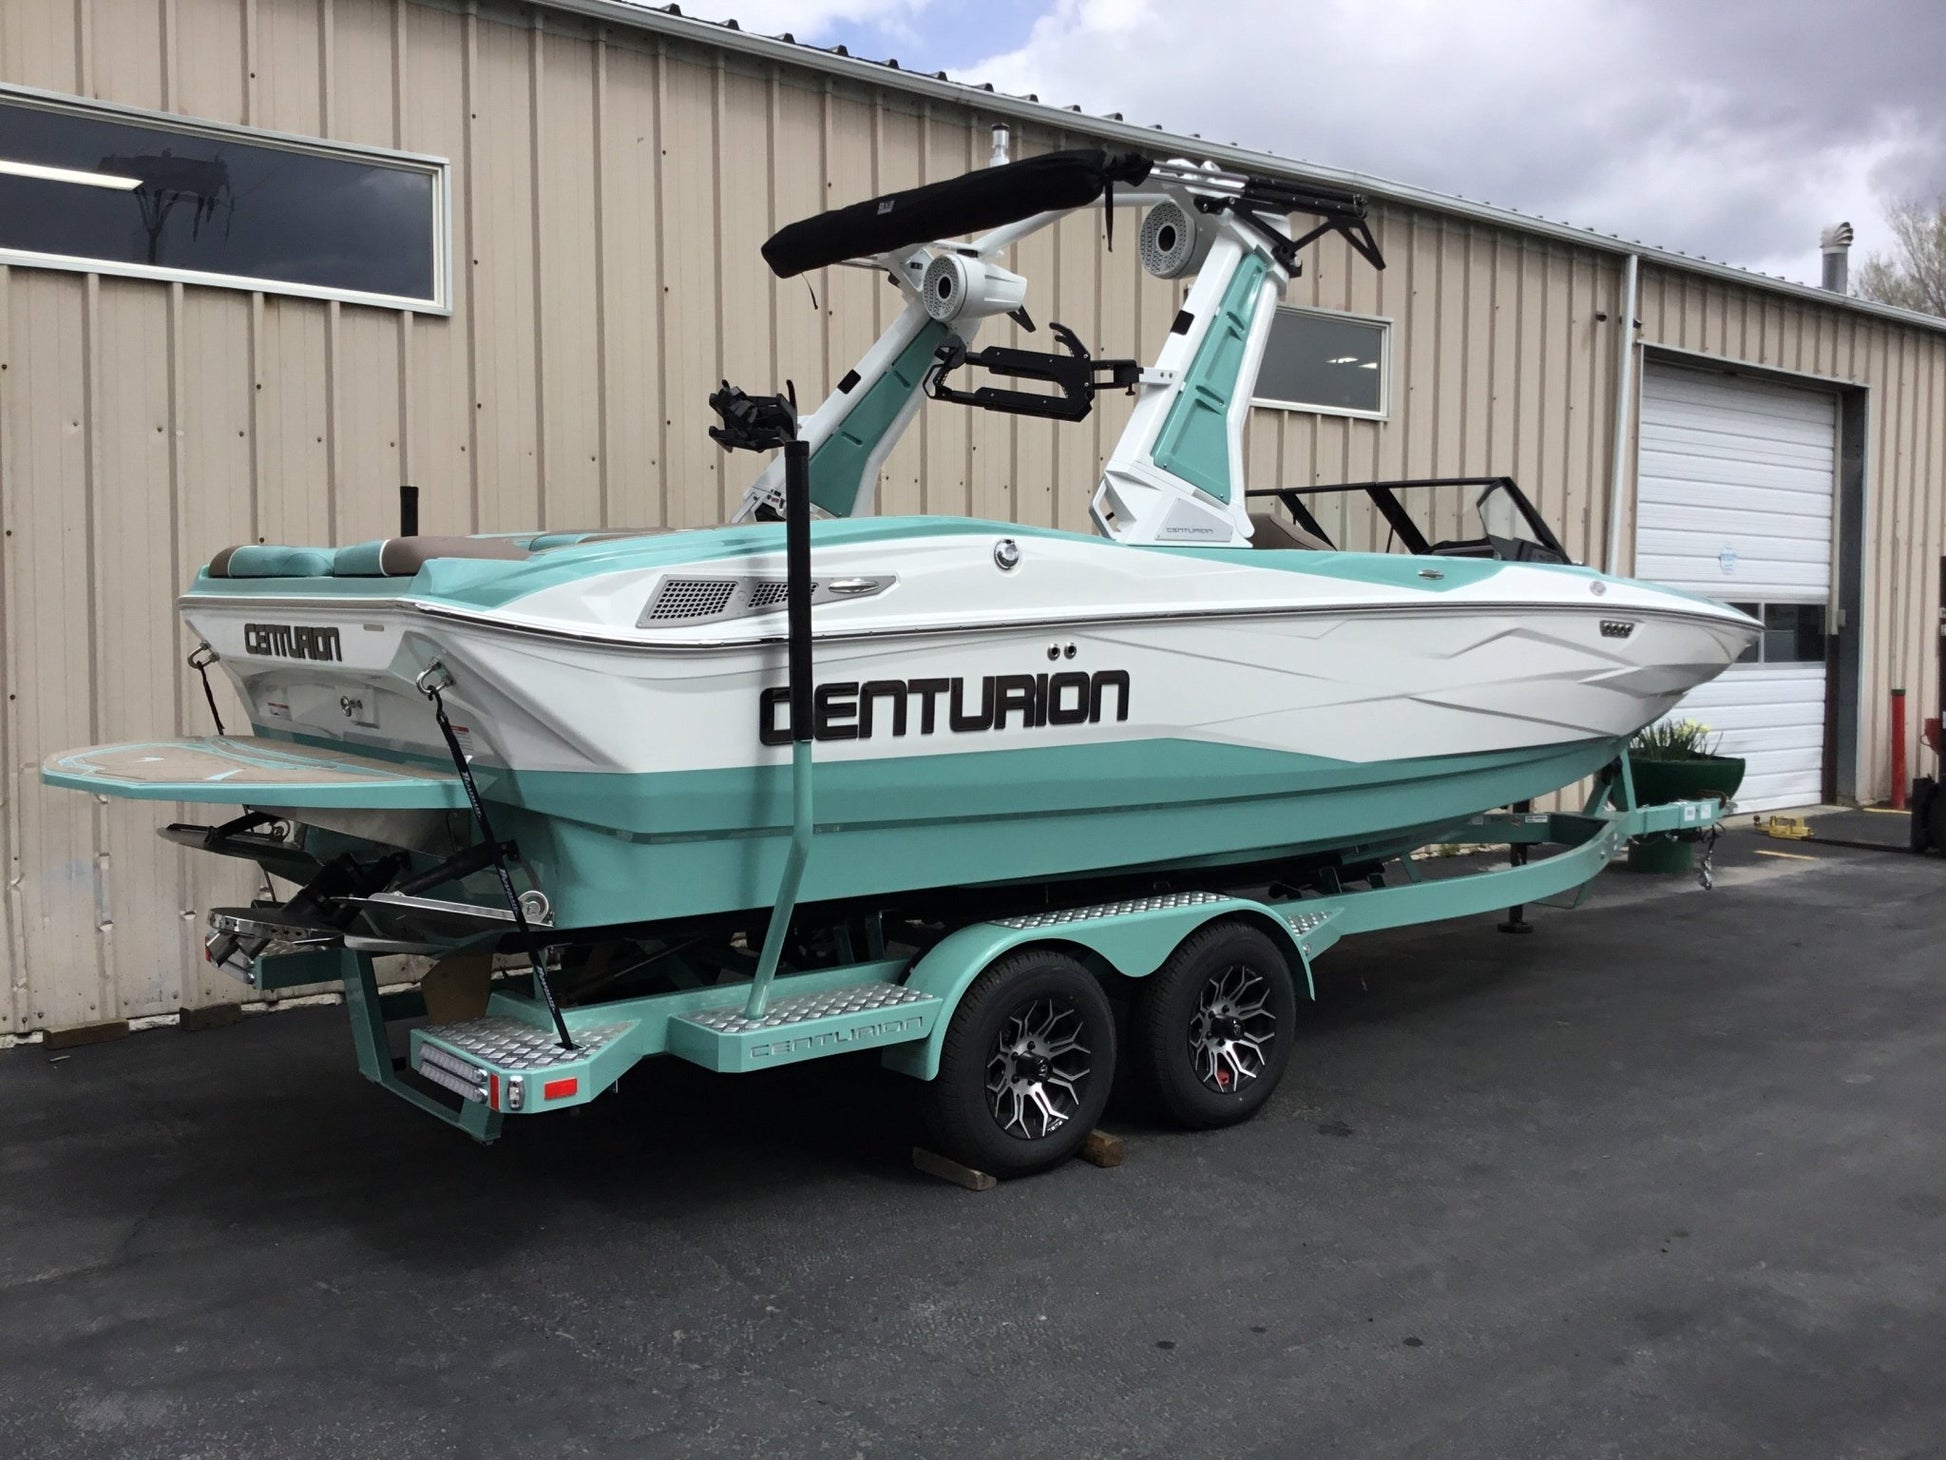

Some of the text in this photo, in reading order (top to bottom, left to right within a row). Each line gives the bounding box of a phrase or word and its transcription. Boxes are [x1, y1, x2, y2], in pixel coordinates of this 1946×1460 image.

[244, 623, 343, 662] CENTURION
[759, 669, 1130, 746] CENTURION
[750, 1016, 923, 1058] CENTURION
